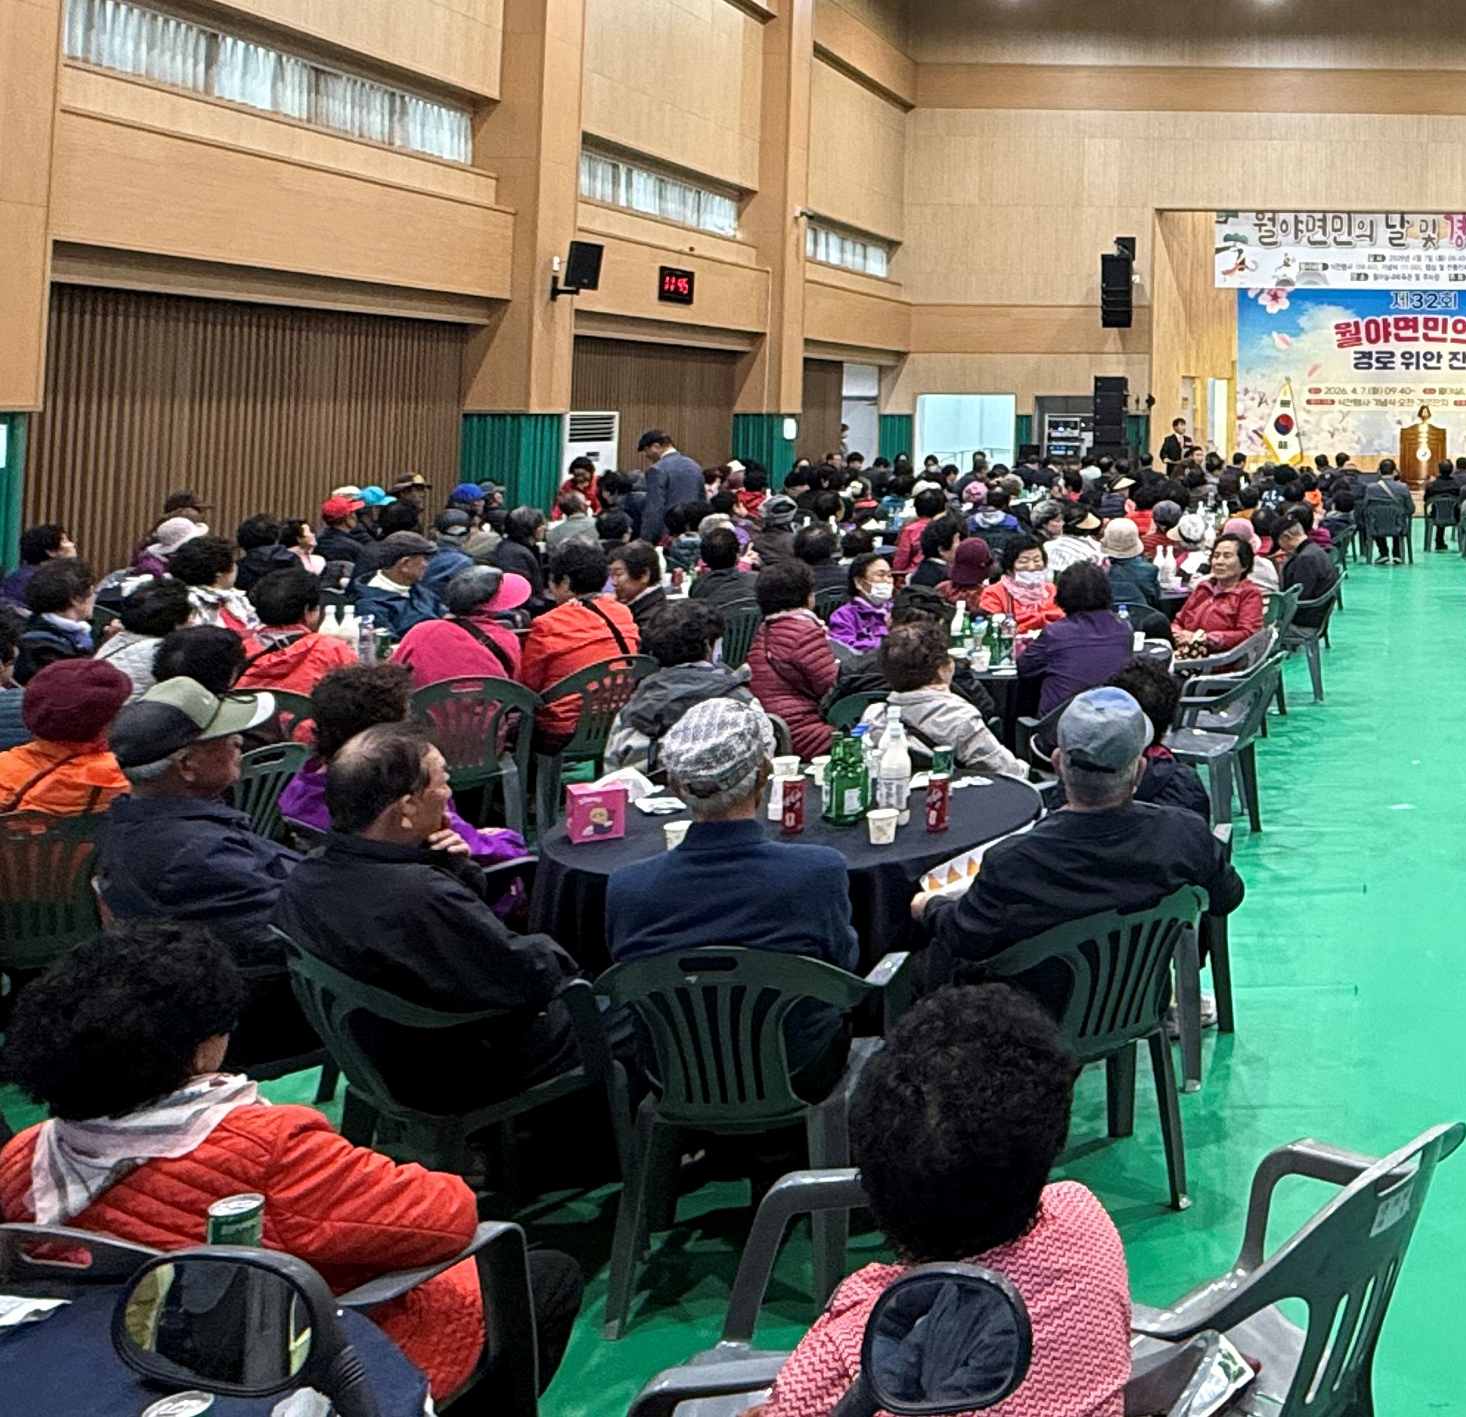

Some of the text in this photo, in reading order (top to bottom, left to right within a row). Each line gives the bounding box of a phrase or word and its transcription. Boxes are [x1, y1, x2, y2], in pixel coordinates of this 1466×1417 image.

[1253, 212, 1376, 247] 월야면민의
[1385, 212, 1410, 249] 날
[1419, 217, 1440, 249] 및
[1390, 291, 1459, 311] 제32회
[1352, 351, 1396, 372] 경로
[1400, 351, 1443, 371] 위안
